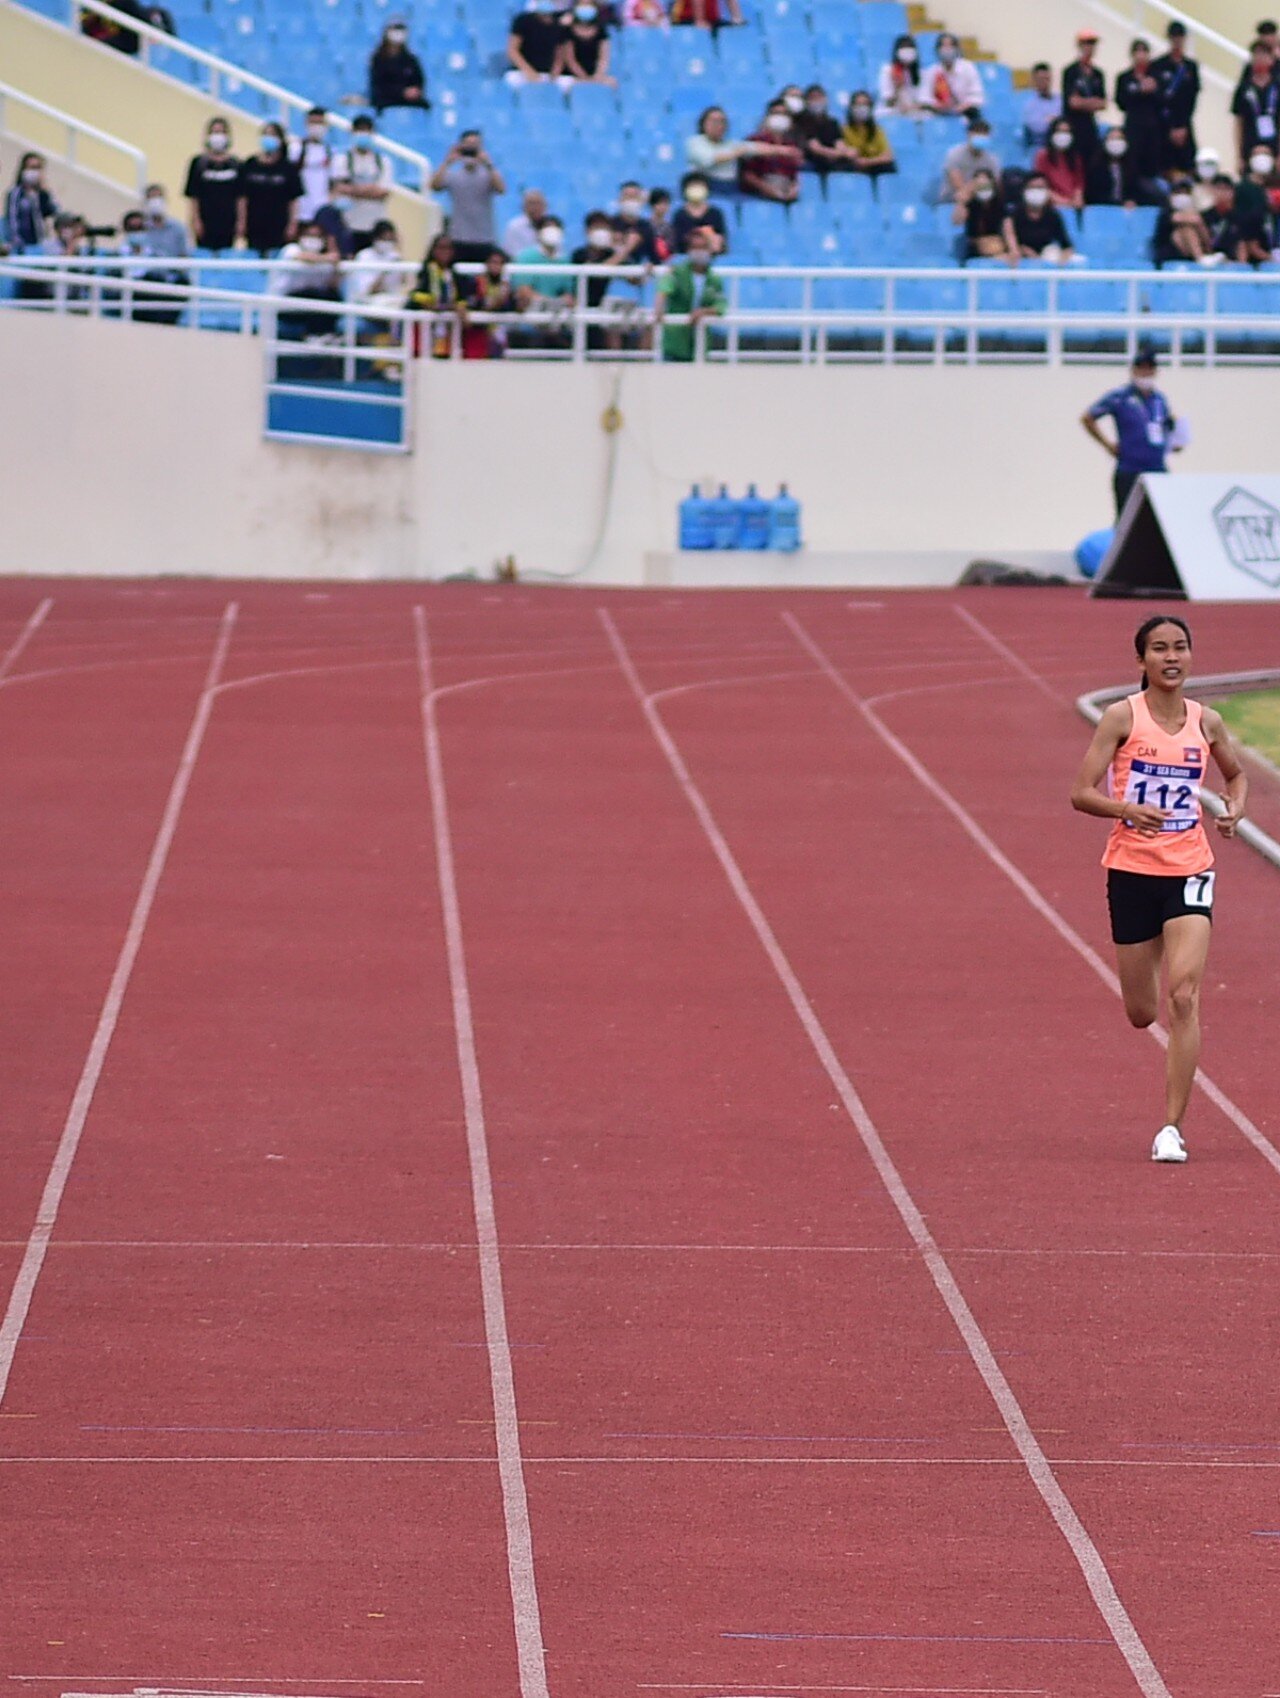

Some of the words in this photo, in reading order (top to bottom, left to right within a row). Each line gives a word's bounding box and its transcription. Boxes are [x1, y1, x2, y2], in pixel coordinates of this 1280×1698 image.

[1138, 747, 1157, 757] CAM
[1134, 781, 1192, 809] 112
[1195, 876, 1210, 901] 7
